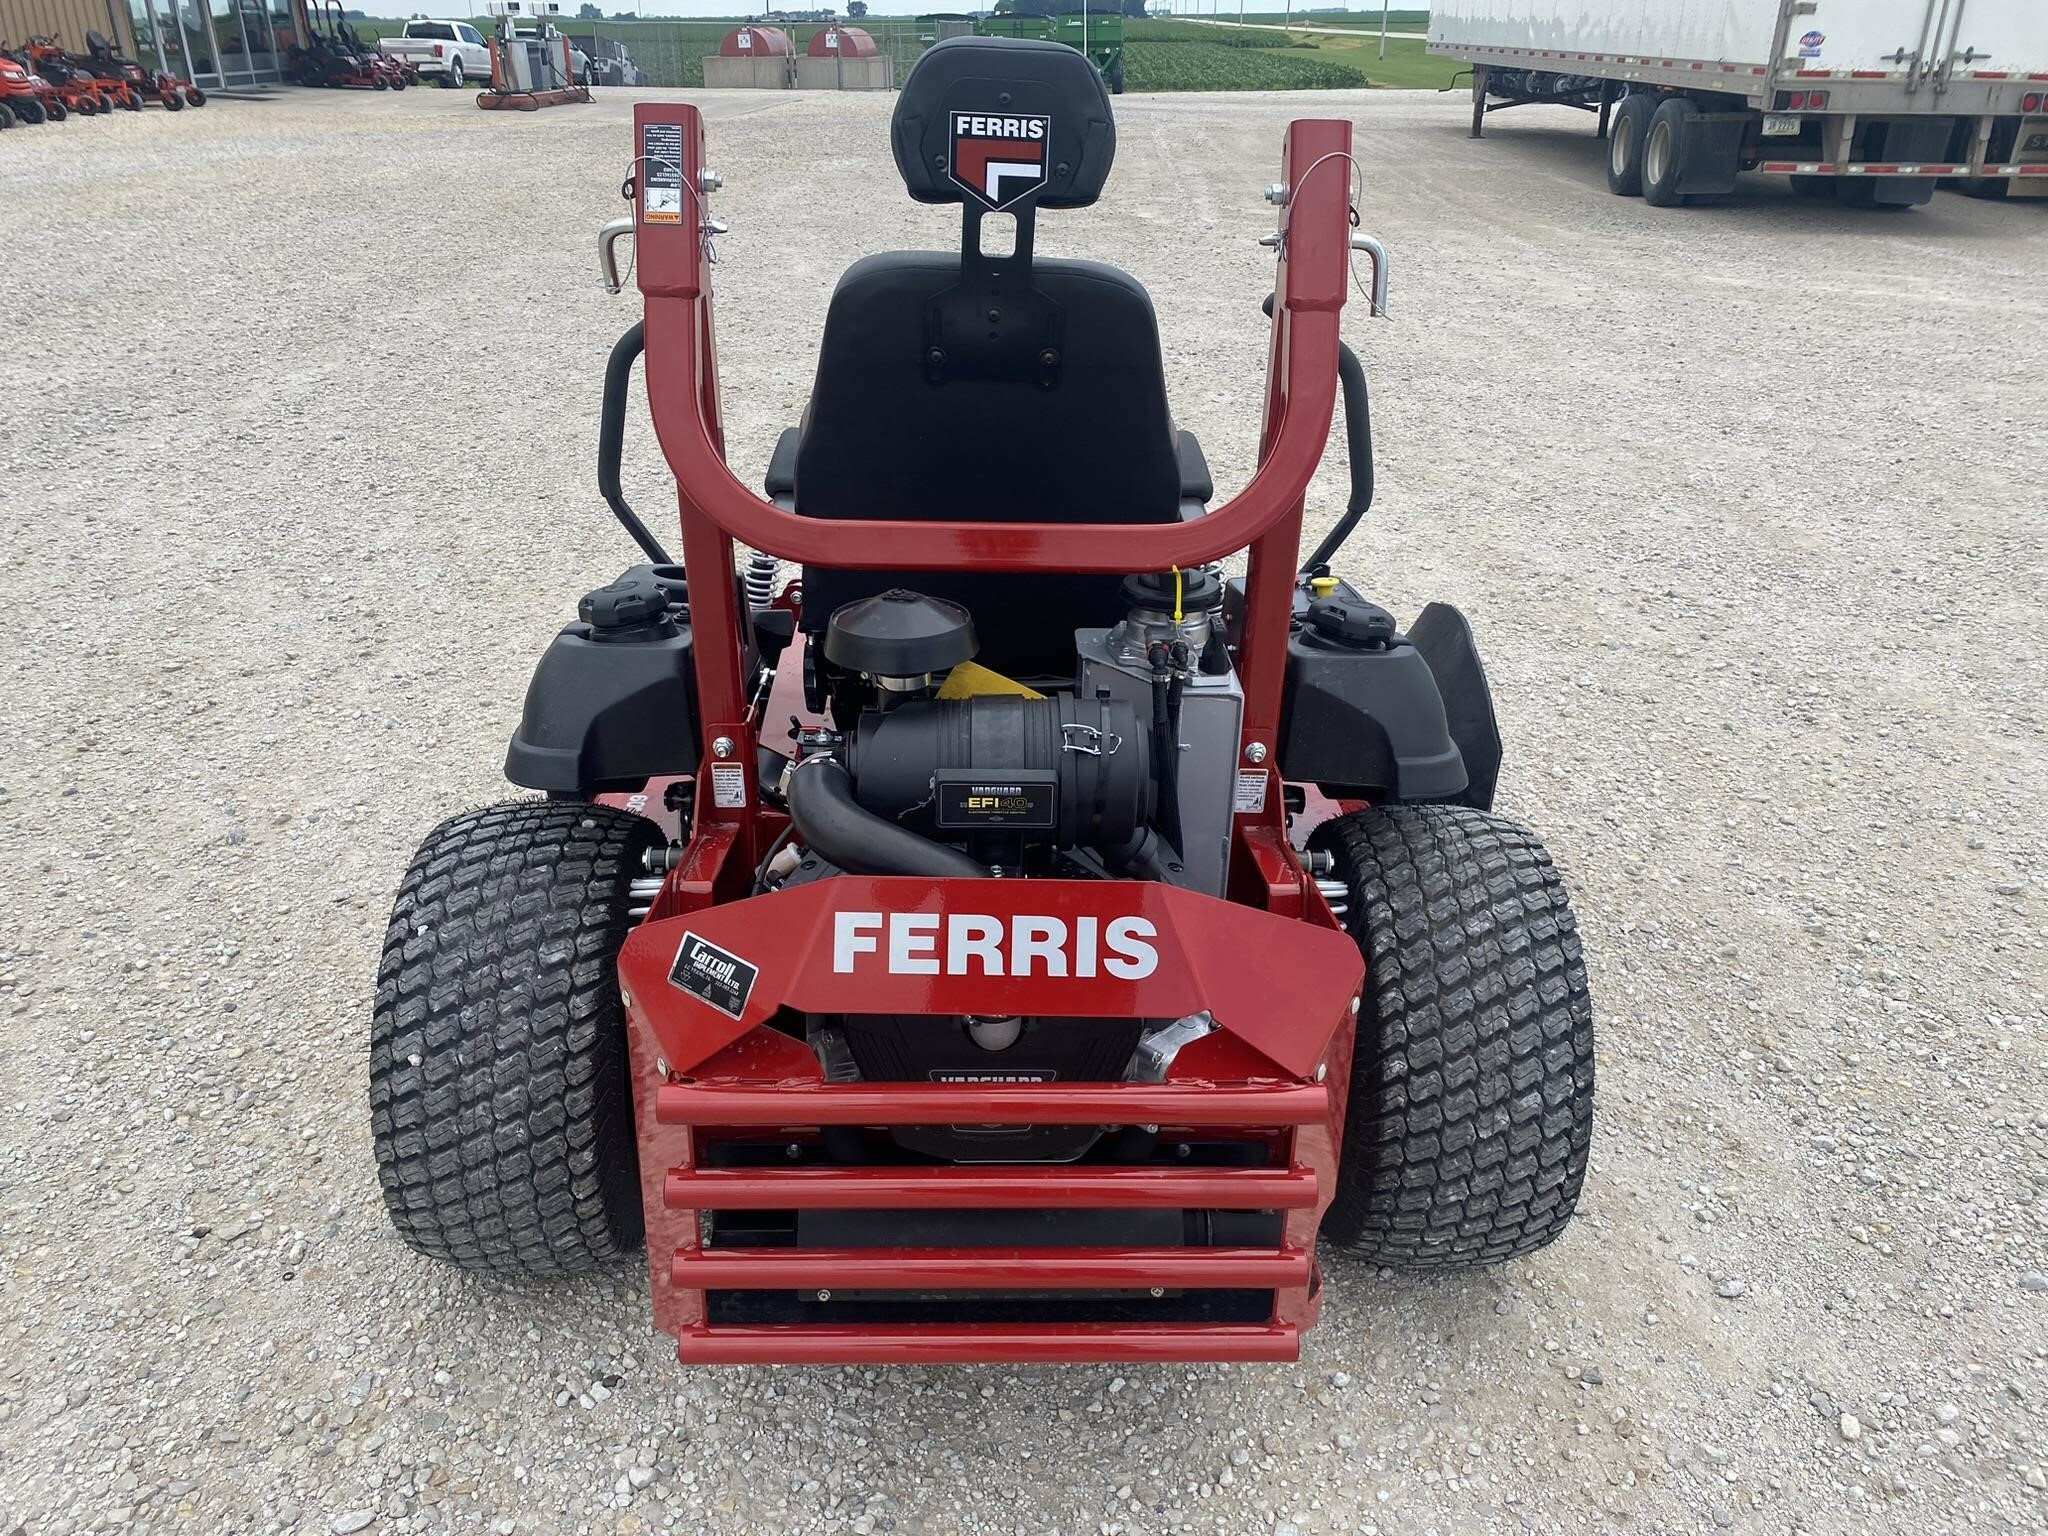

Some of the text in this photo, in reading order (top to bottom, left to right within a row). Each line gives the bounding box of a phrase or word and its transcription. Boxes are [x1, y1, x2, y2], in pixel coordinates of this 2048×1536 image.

[957, 116, 1044, 138] FERRIS
[971, 786, 1022, 795] VANGUARD
[833, 911, 1159, 980] FERRIS
[689, 941, 737, 983] Carroll
